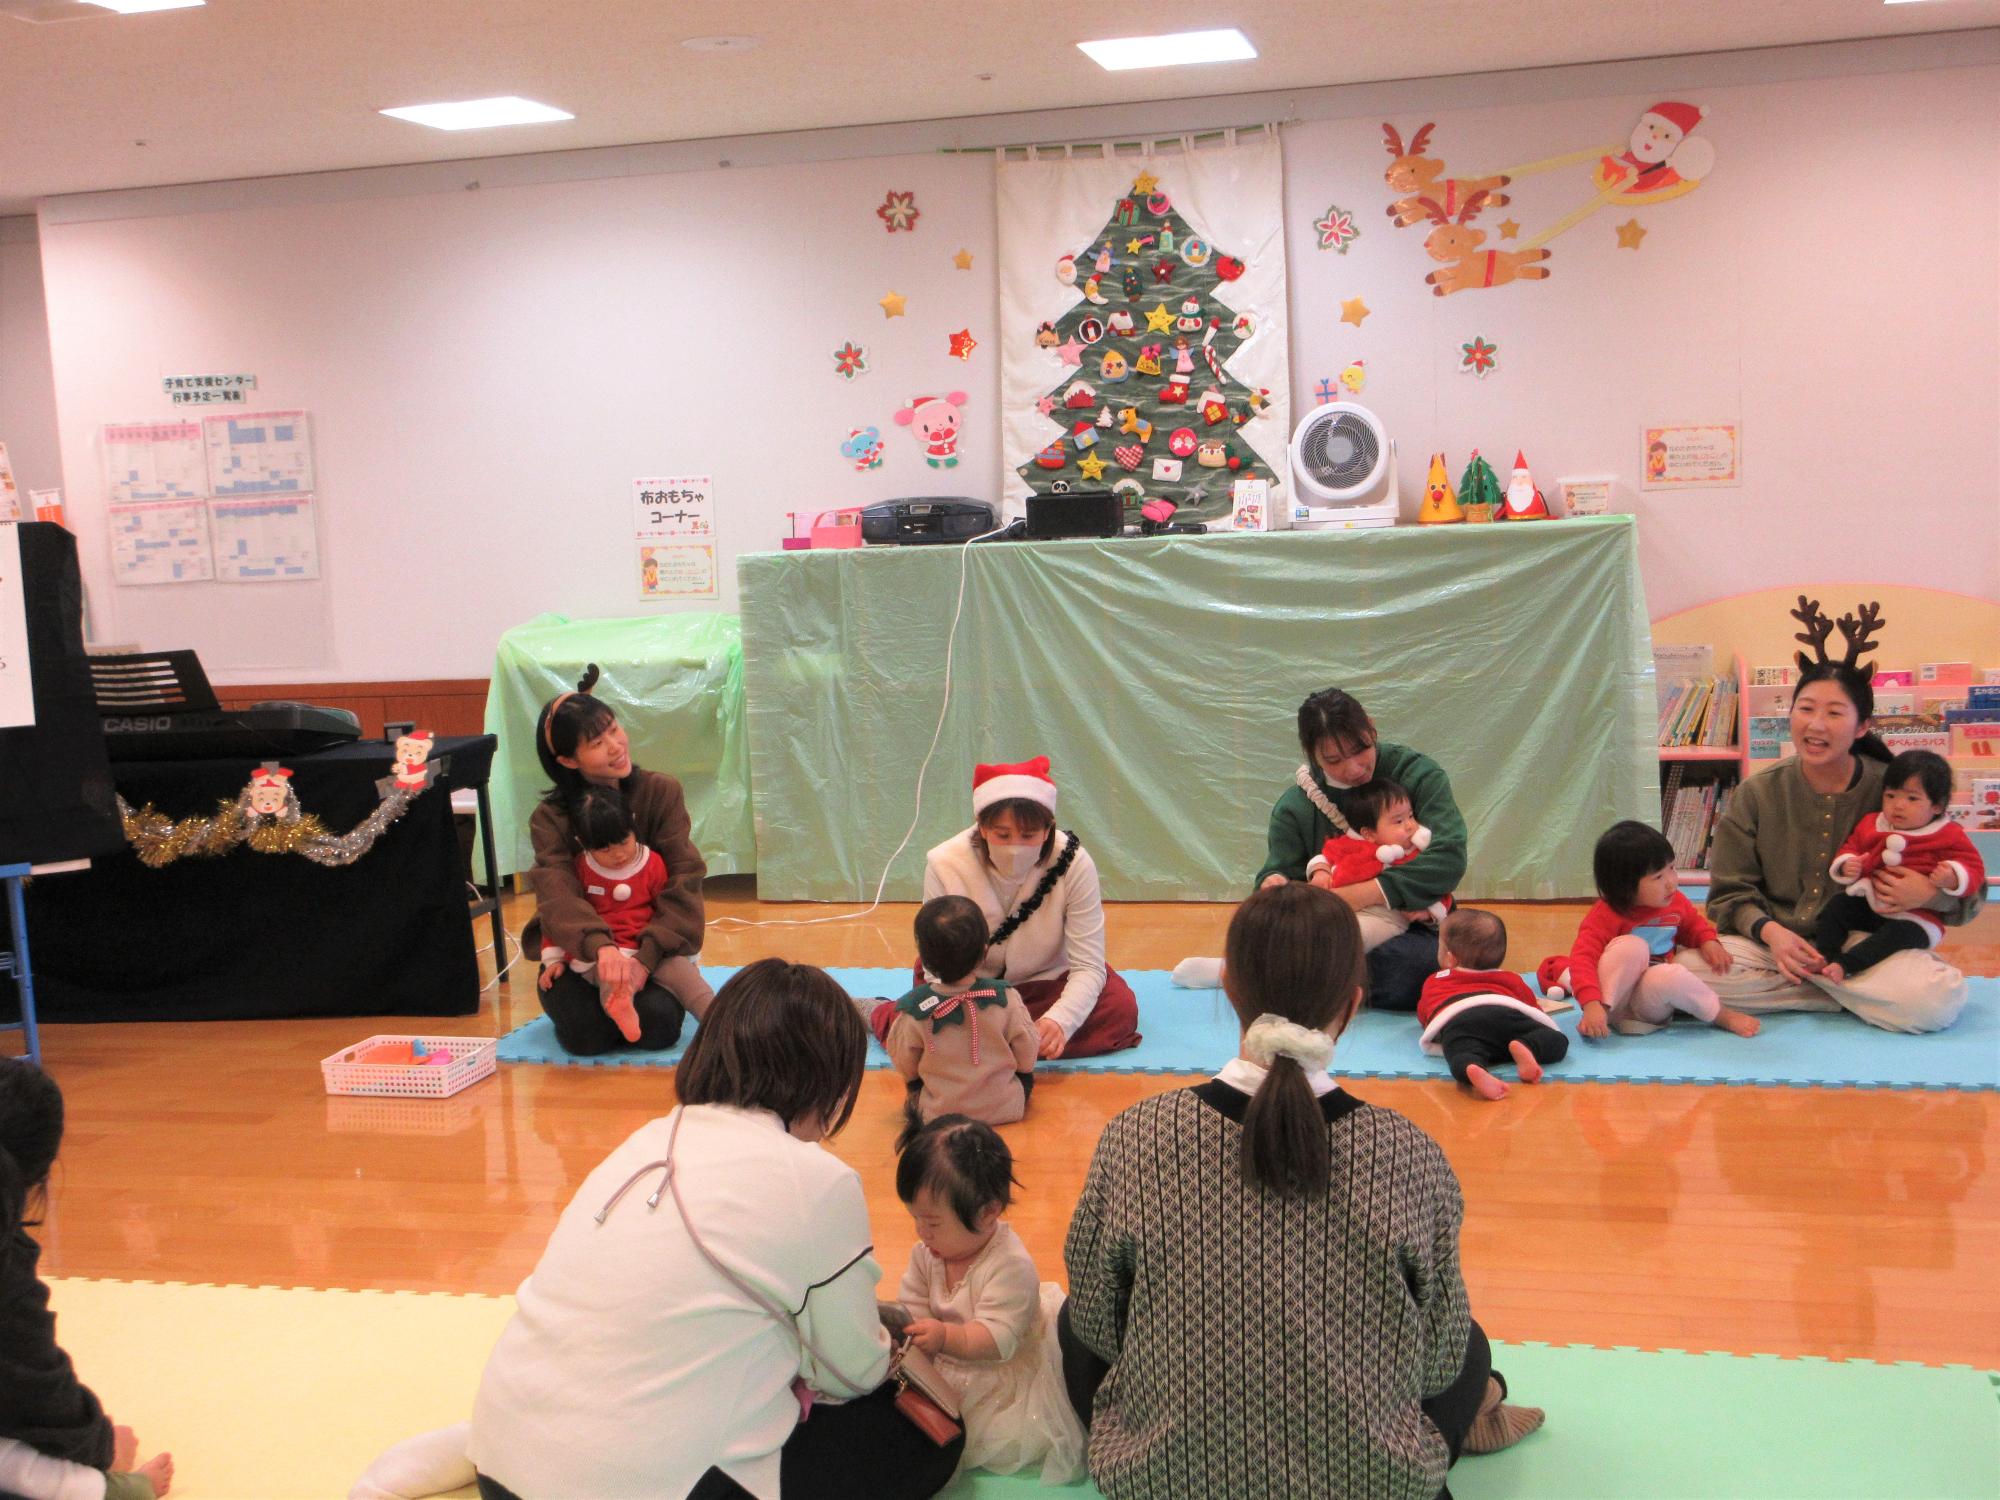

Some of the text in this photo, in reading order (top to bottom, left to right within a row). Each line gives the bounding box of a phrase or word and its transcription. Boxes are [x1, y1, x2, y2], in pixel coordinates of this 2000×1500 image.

[640, 489, 704, 505] 布おもちゃ
[651, 509, 700, 524] コーナー
[104, 716, 171, 732] CASIO
[1887, 738, 1946, 747] おべんとうバス
